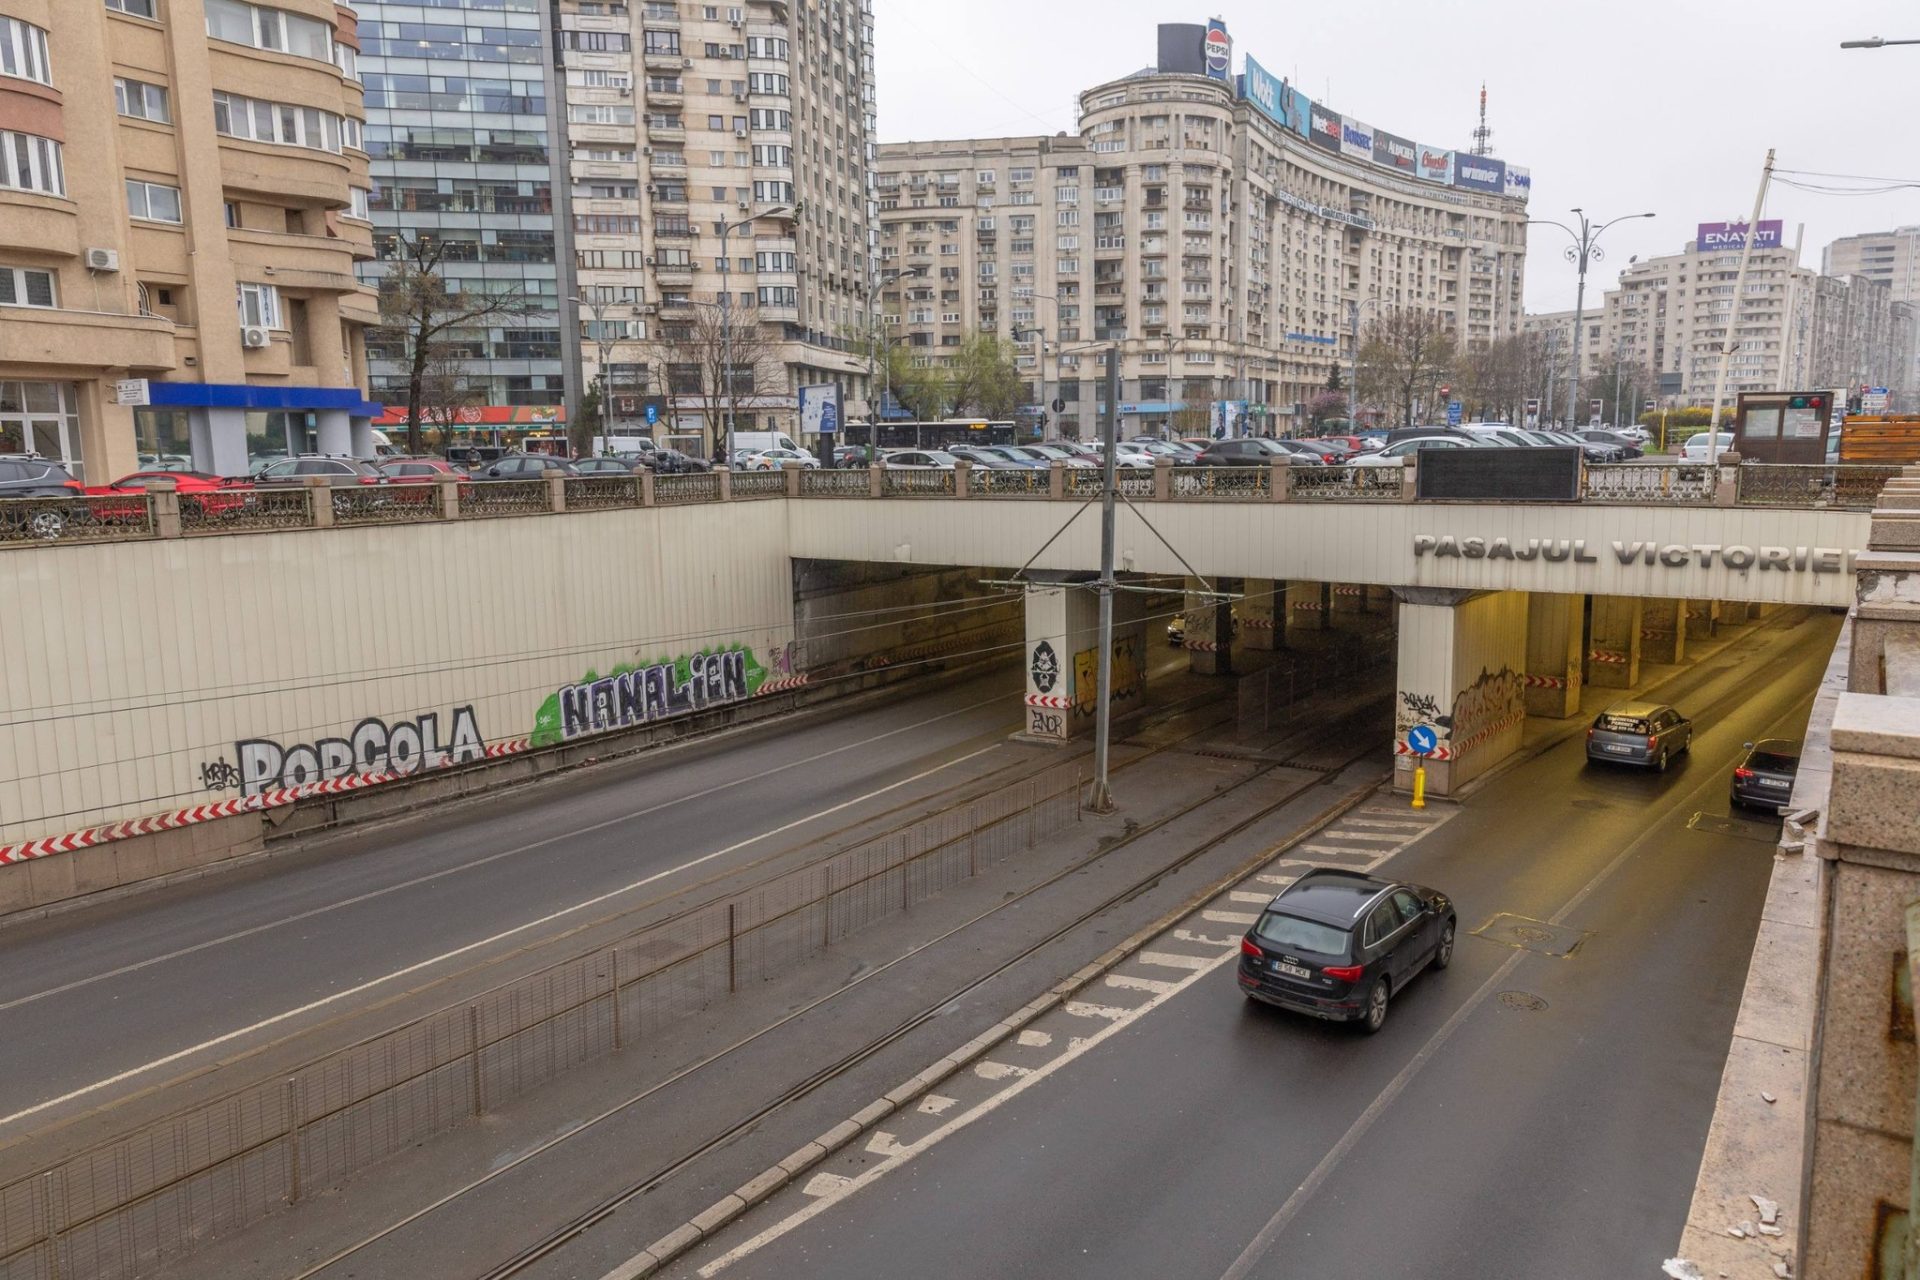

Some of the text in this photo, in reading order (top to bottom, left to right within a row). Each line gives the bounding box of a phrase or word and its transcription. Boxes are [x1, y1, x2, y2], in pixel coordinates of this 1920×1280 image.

[1206, 42, 1228, 56] PEPSI
[1705, 231, 1774, 243] ENAYATI
[1414, 535, 1597, 564] PASAJUL
